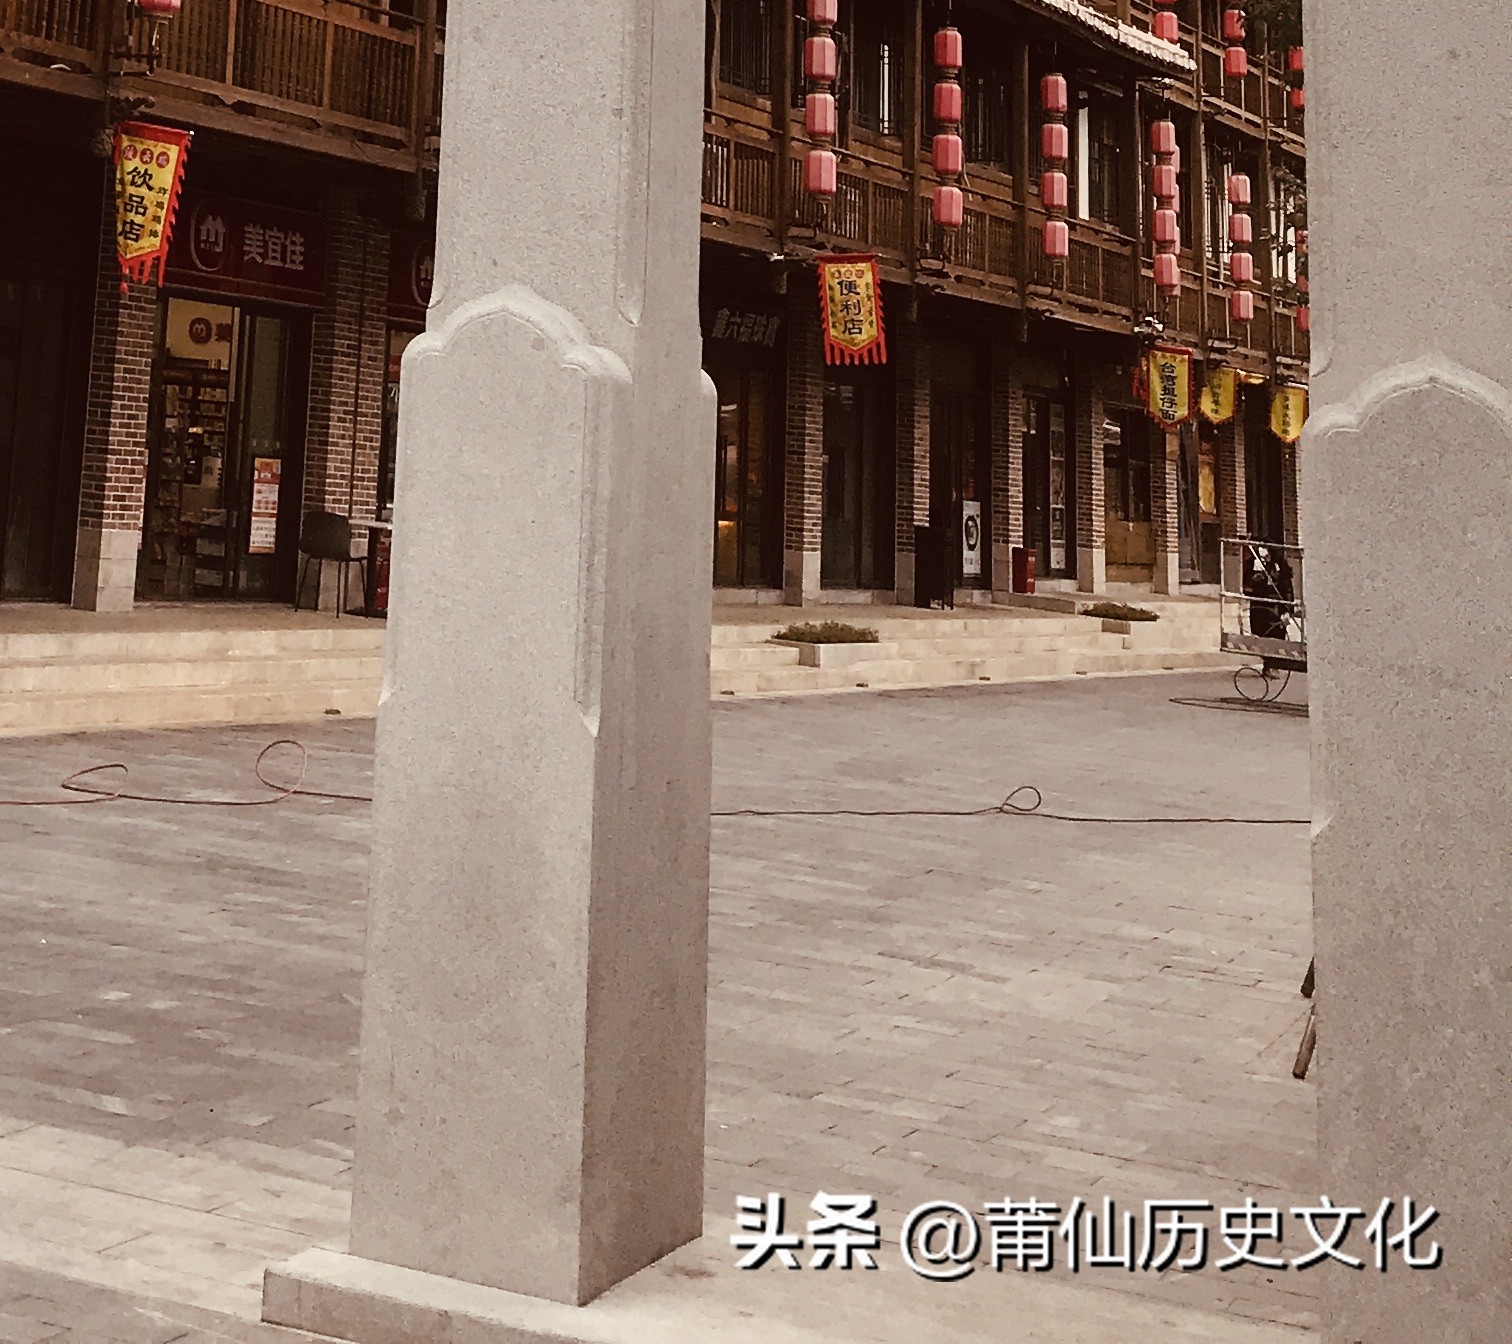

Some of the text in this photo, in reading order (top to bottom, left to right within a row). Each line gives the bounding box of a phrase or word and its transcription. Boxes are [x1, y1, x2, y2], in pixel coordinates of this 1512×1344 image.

[117, 165, 155, 244] 饮品店
[242, 222, 306, 272] 美宜佳
[836, 279, 864, 336] 便利店
